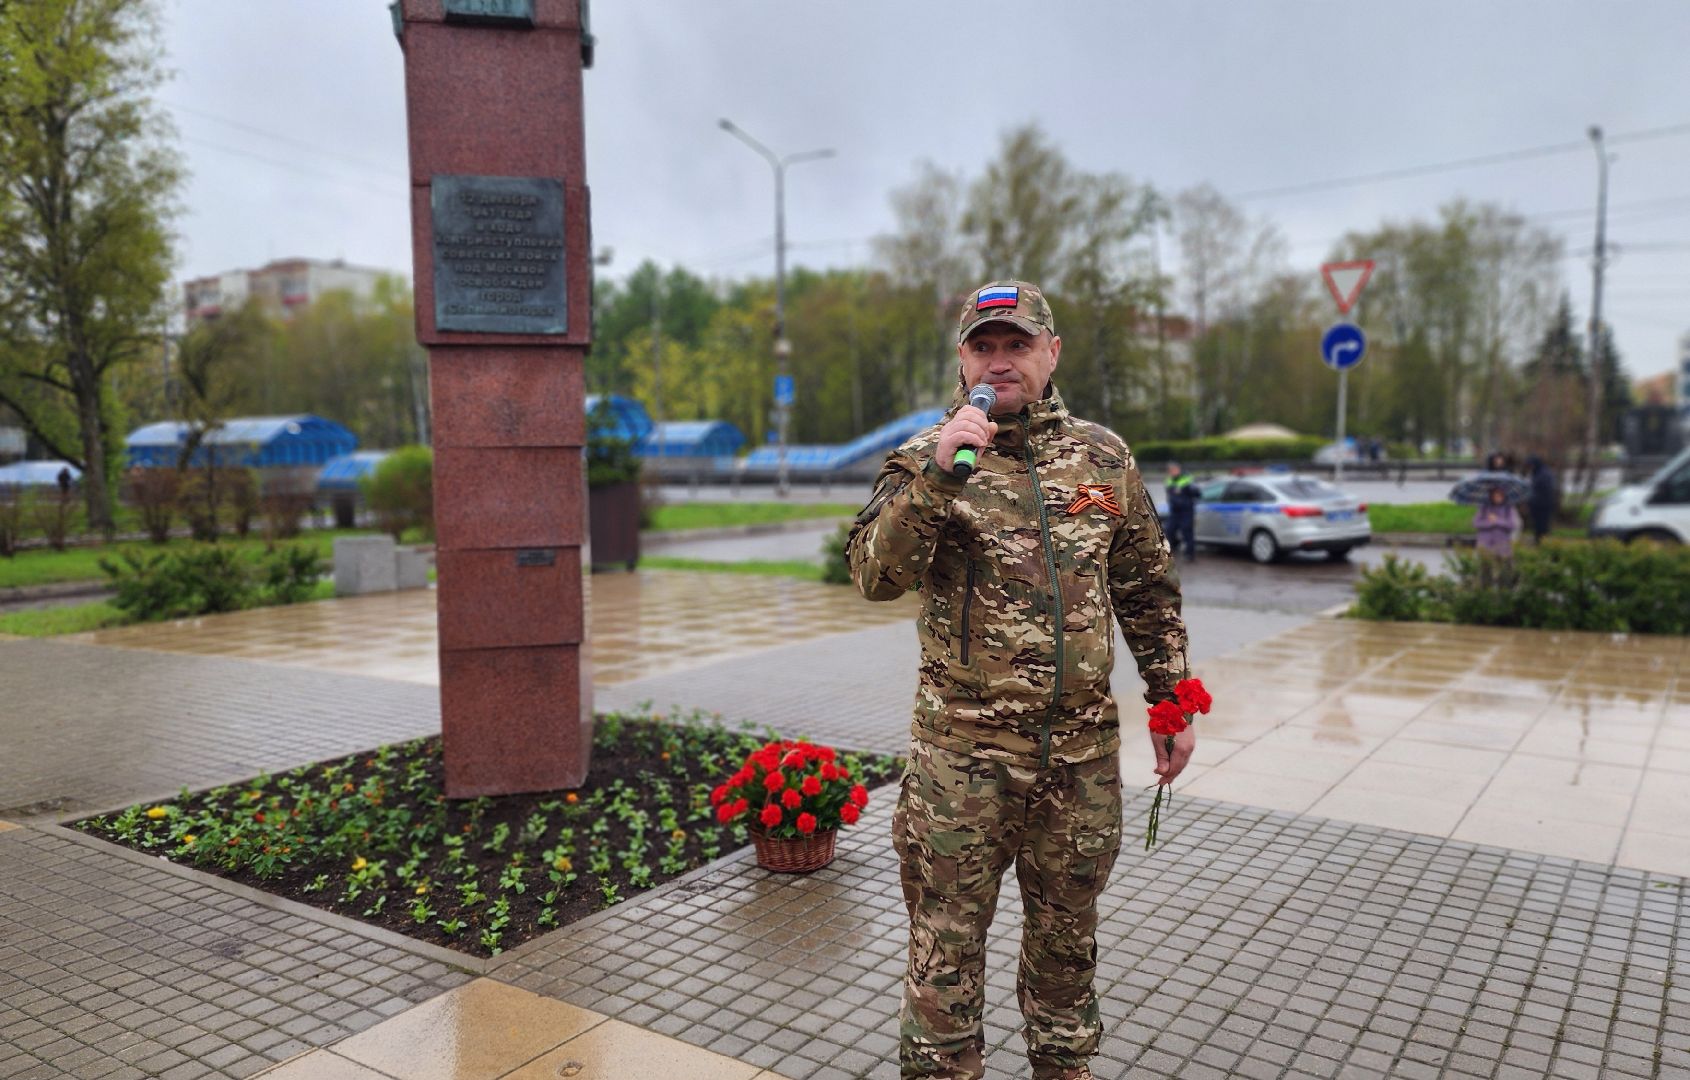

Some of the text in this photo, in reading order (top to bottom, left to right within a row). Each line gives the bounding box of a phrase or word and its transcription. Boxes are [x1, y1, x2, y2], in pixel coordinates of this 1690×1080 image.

[500, 209, 532, 220] года
[490, 222, 522, 233] ходе
[442, 248, 557, 261] советских войск
[455, 262, 545, 274] под Москвой
[481, 291, 521, 303] город
